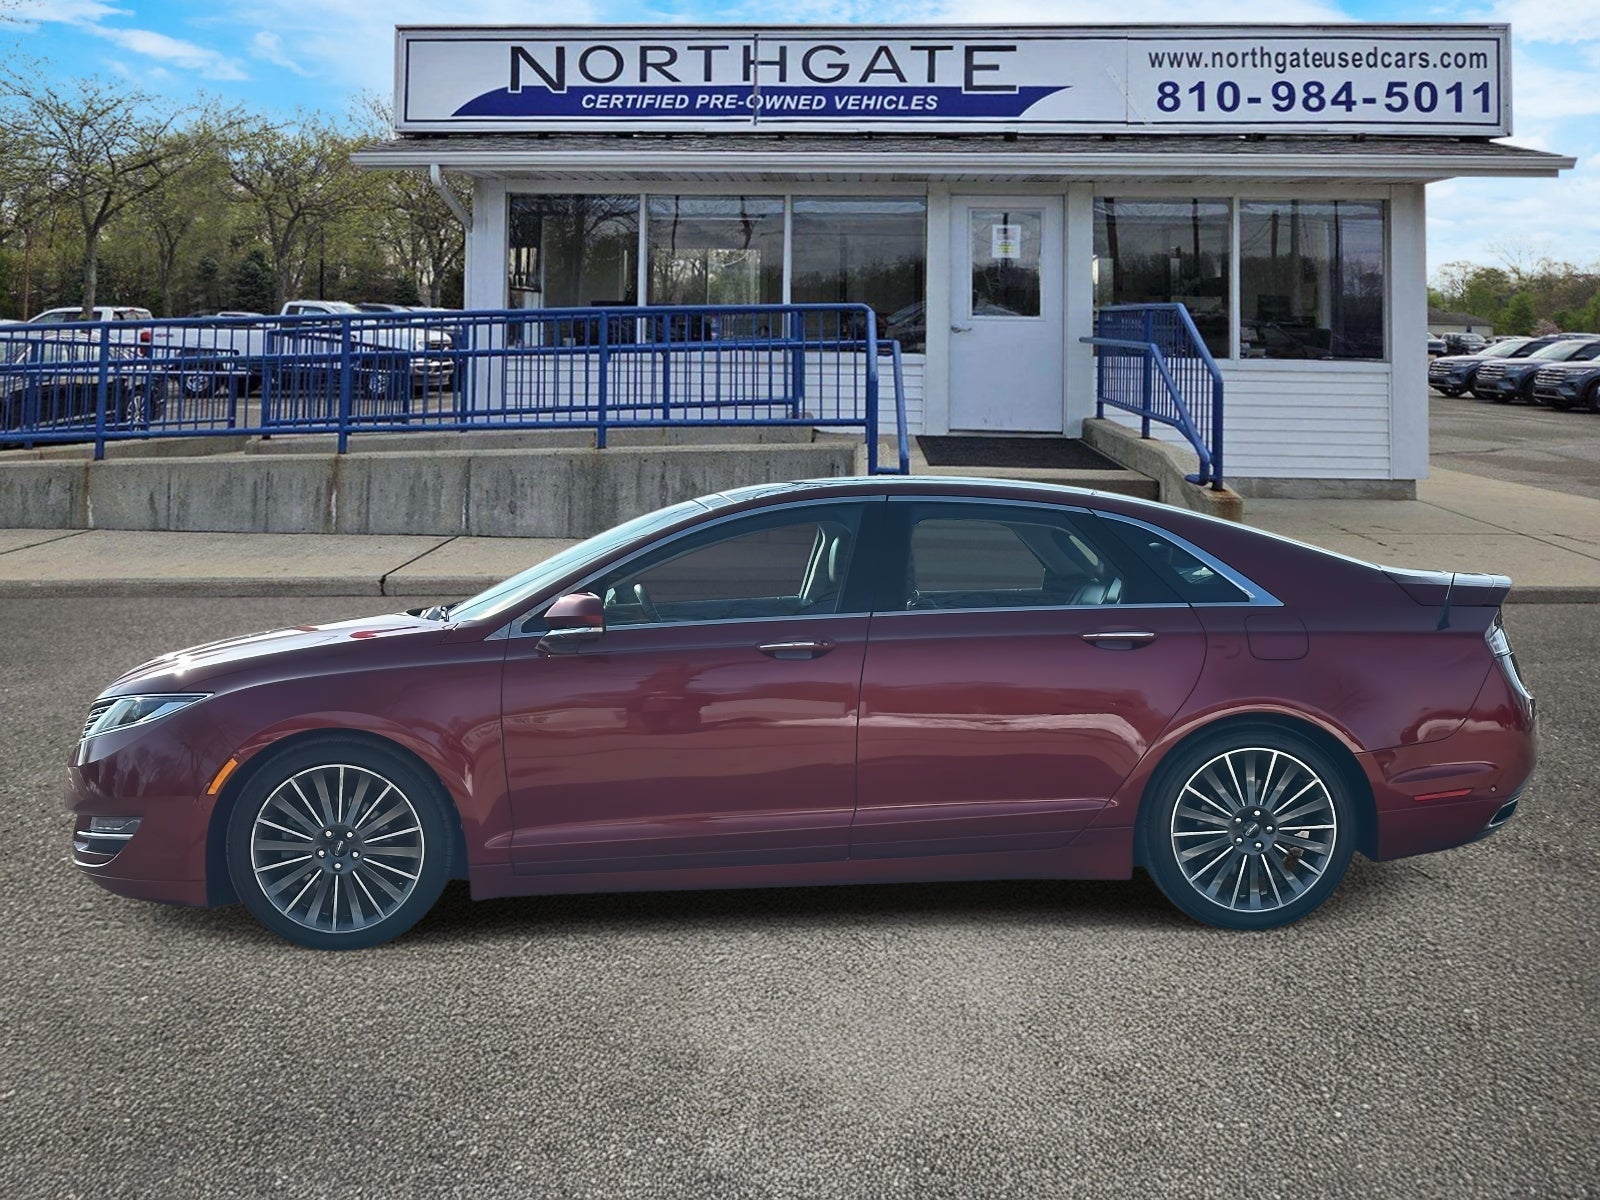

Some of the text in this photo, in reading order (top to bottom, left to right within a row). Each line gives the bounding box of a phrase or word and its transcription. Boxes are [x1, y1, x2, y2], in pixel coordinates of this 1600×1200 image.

[510, 46, 1017, 92] NORTHGATE
[1149, 46, 1488, 73] www.northgateusedcars.com
[581, 95, 938, 110] CERTIFIED PRE-OWNED VEHICLES
[1157, 81, 1491, 114] 810-984-5011
